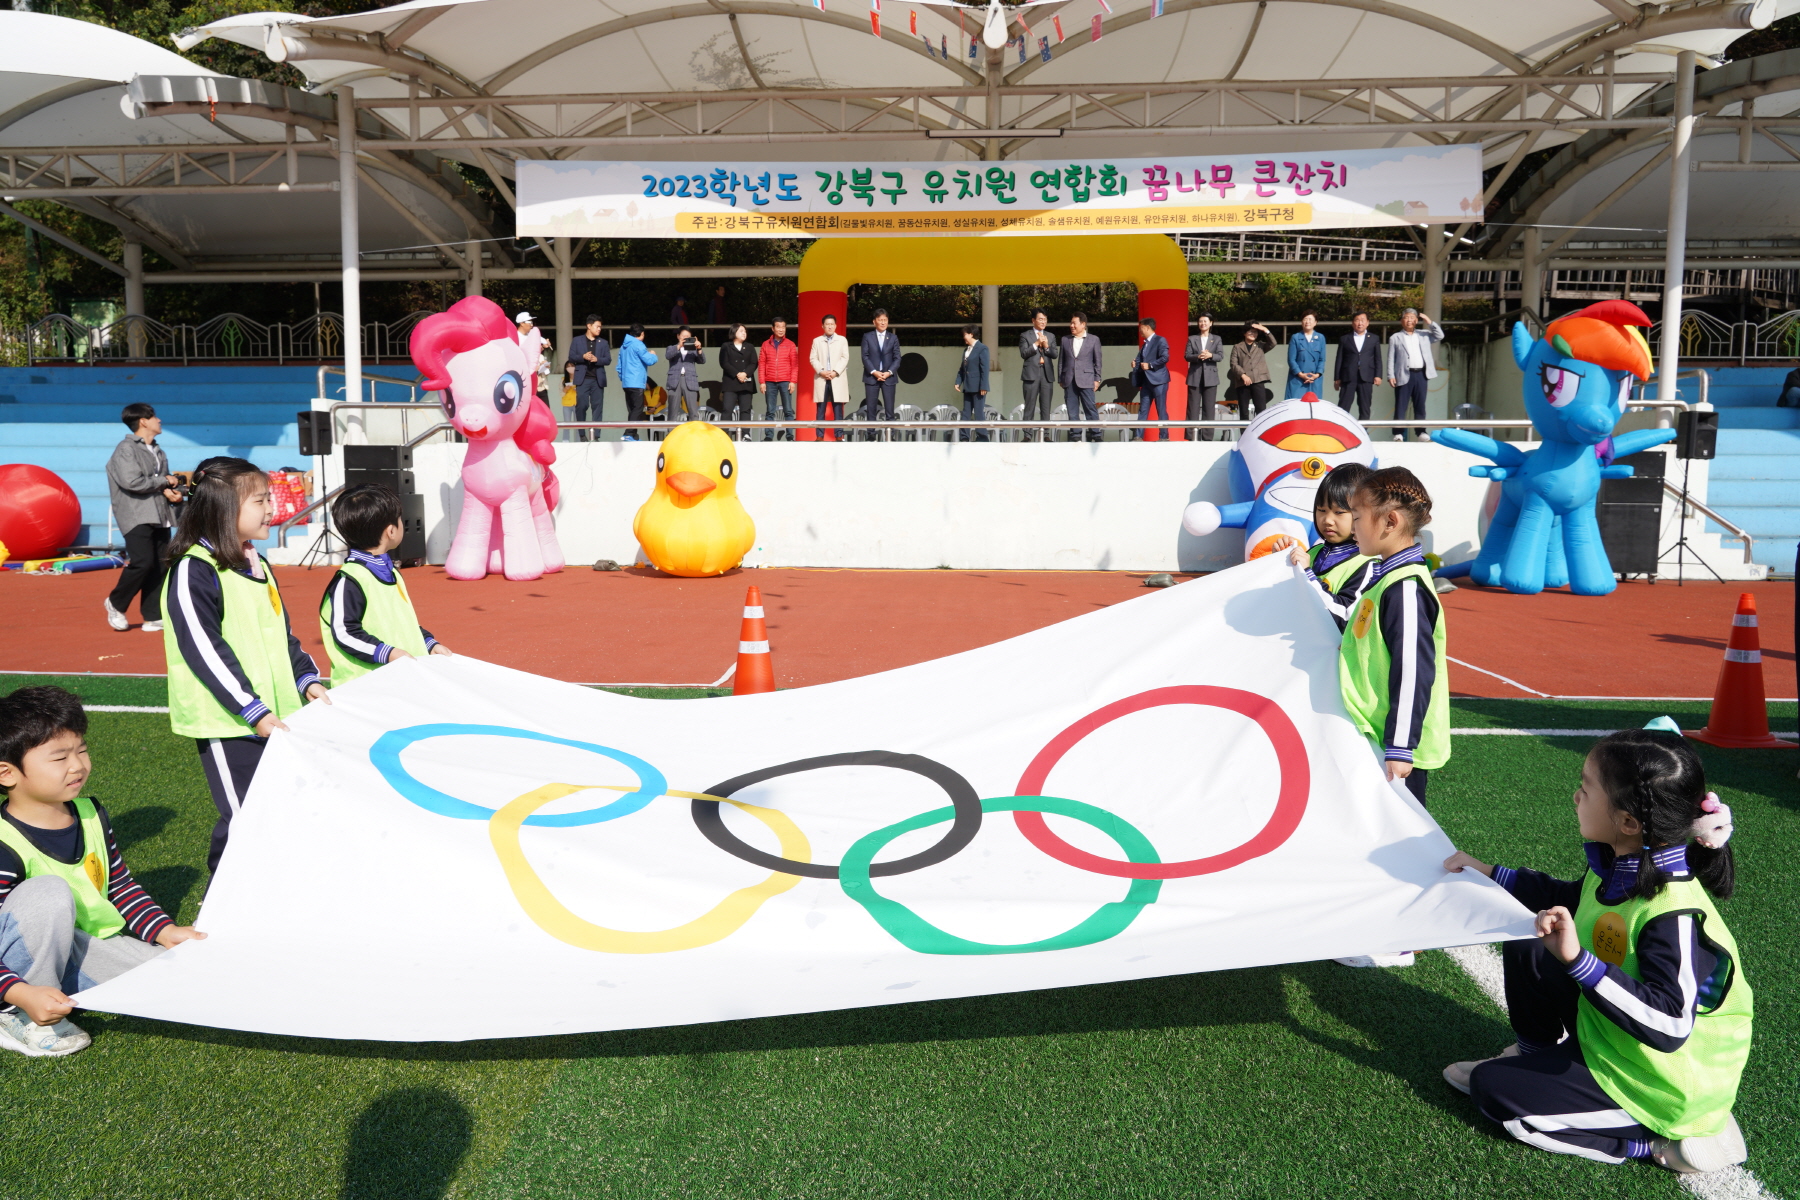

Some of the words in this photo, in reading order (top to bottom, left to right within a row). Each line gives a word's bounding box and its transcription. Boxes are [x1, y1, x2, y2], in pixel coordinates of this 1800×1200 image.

[641, 167, 803, 206] 2023학년도
[815, 167, 908, 205] 강북구
[922, 167, 1018, 204] 유치원
[1029, 163, 1128, 203] 연합회
[1142, 163, 1236, 201] 꿈나무
[1252, 160, 1348, 197] 큰잔치
[1243, 207, 1294, 223] 강북구청
